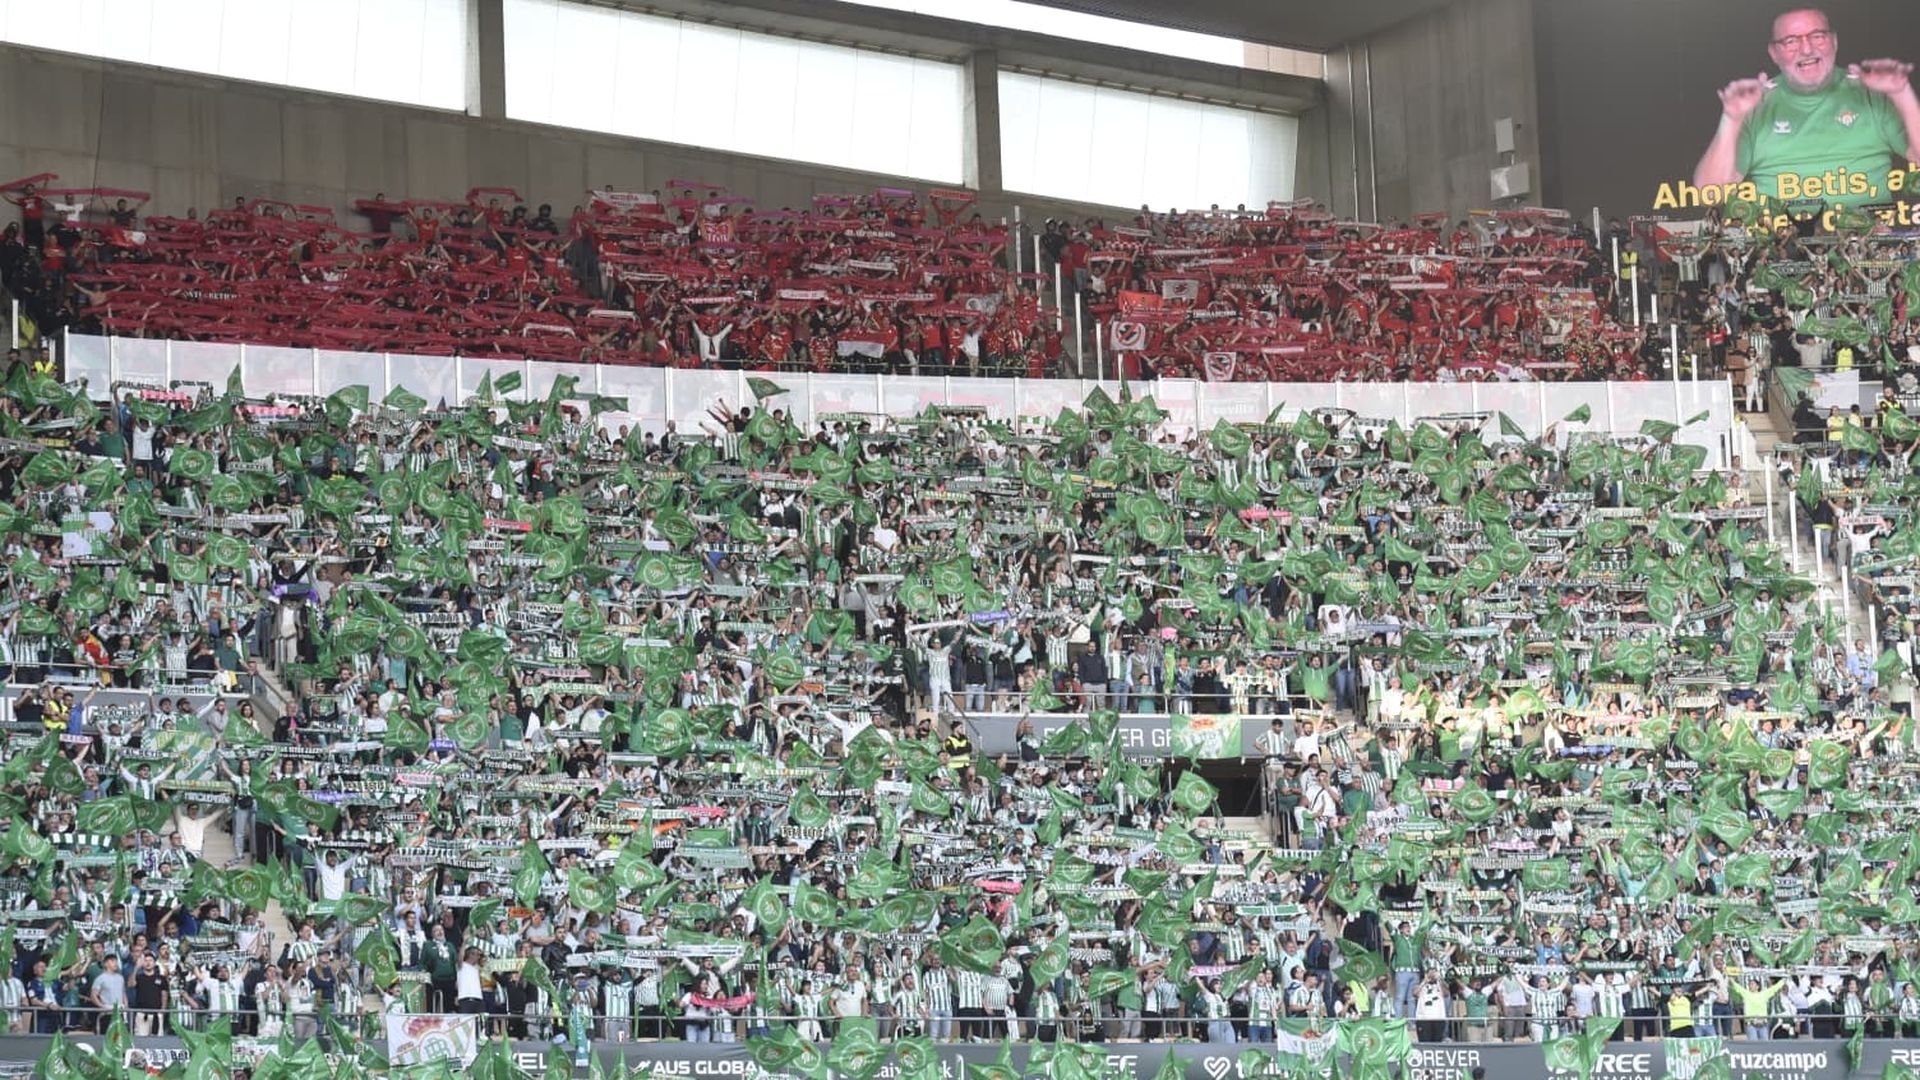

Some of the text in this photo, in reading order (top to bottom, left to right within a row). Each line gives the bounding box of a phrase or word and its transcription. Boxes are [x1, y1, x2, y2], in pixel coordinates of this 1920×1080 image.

[1652, 180, 1767, 210] Ahora,
[1777, 167, 1879, 200] Betis,
[652, 1060, 690, 1075] AUS
